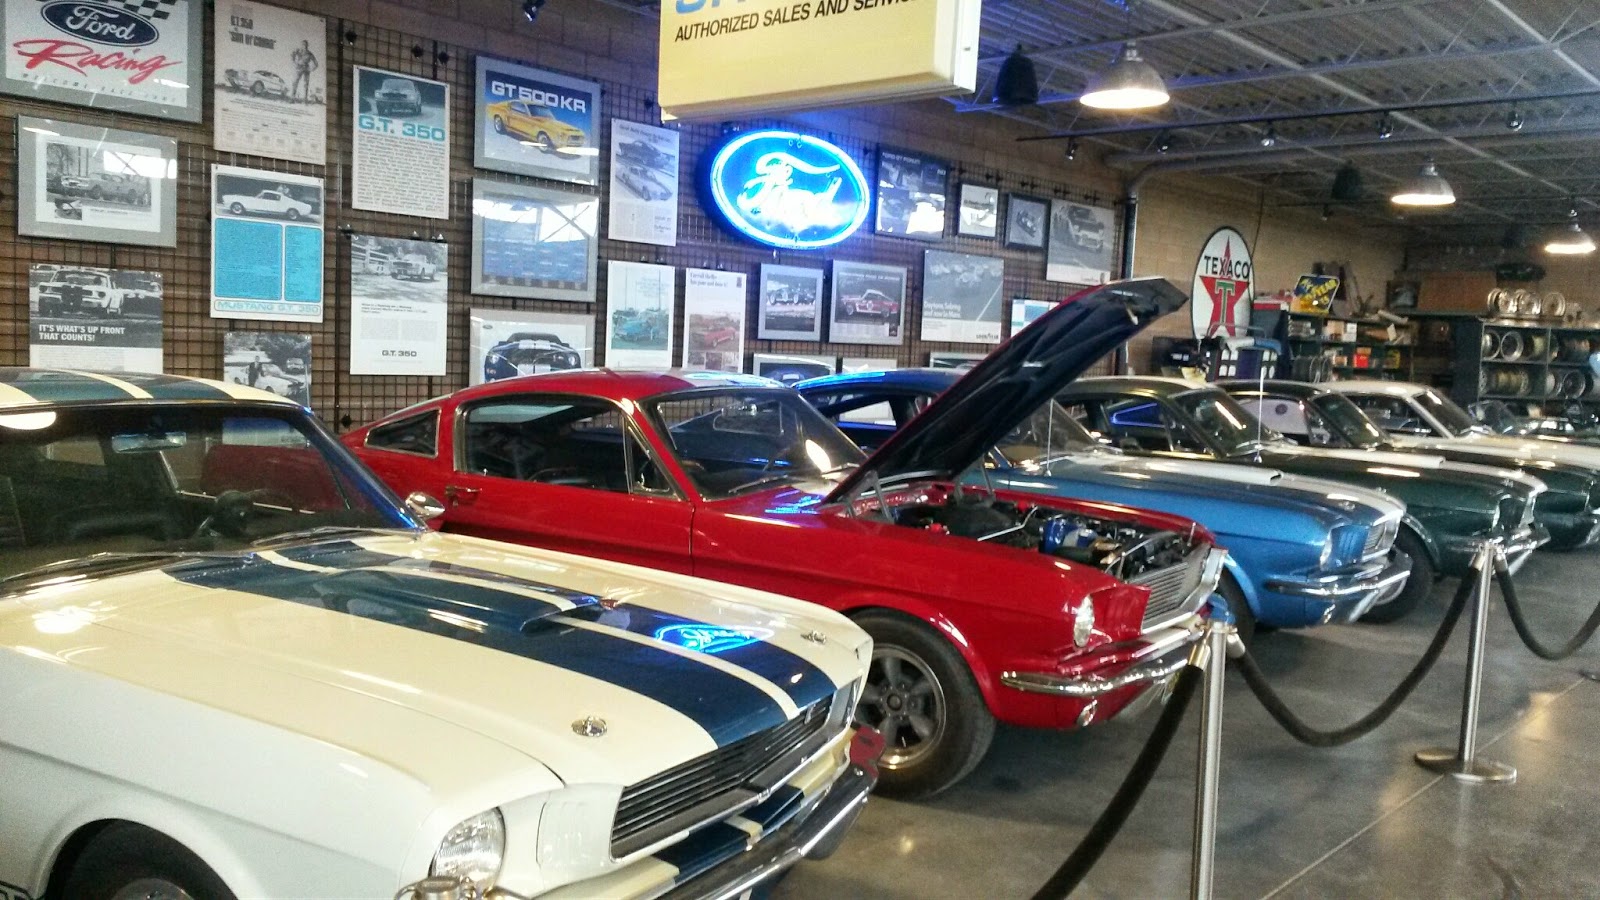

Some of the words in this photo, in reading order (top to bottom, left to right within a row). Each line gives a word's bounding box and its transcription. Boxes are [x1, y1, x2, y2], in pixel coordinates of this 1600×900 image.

[65, 6, 135, 40] Ford
[674, 13, 760, 42] AUTHORIZED
[763, 3, 811, 27] SALES
[814, 0, 849, 18] AND
[13, 39, 183, 84] Racing
[358, 114, 395, 134] G.T.
[402, 122, 446, 142] 350
[737, 151, 843, 217] Ford
[1204, 255, 1250, 279] TEXACO
[217, 301, 273, 311] MUSTANG
[1214, 280, 1235, 325] T
[39, 324, 55, 333] IT'S
[56, 324, 86, 334] WHAT'S
[87, 326, 99, 334] UP
[100, 326, 126, 335] FRONT
[39, 332, 59, 341] THAT
[61, 333, 96, 342] COUNTS!
